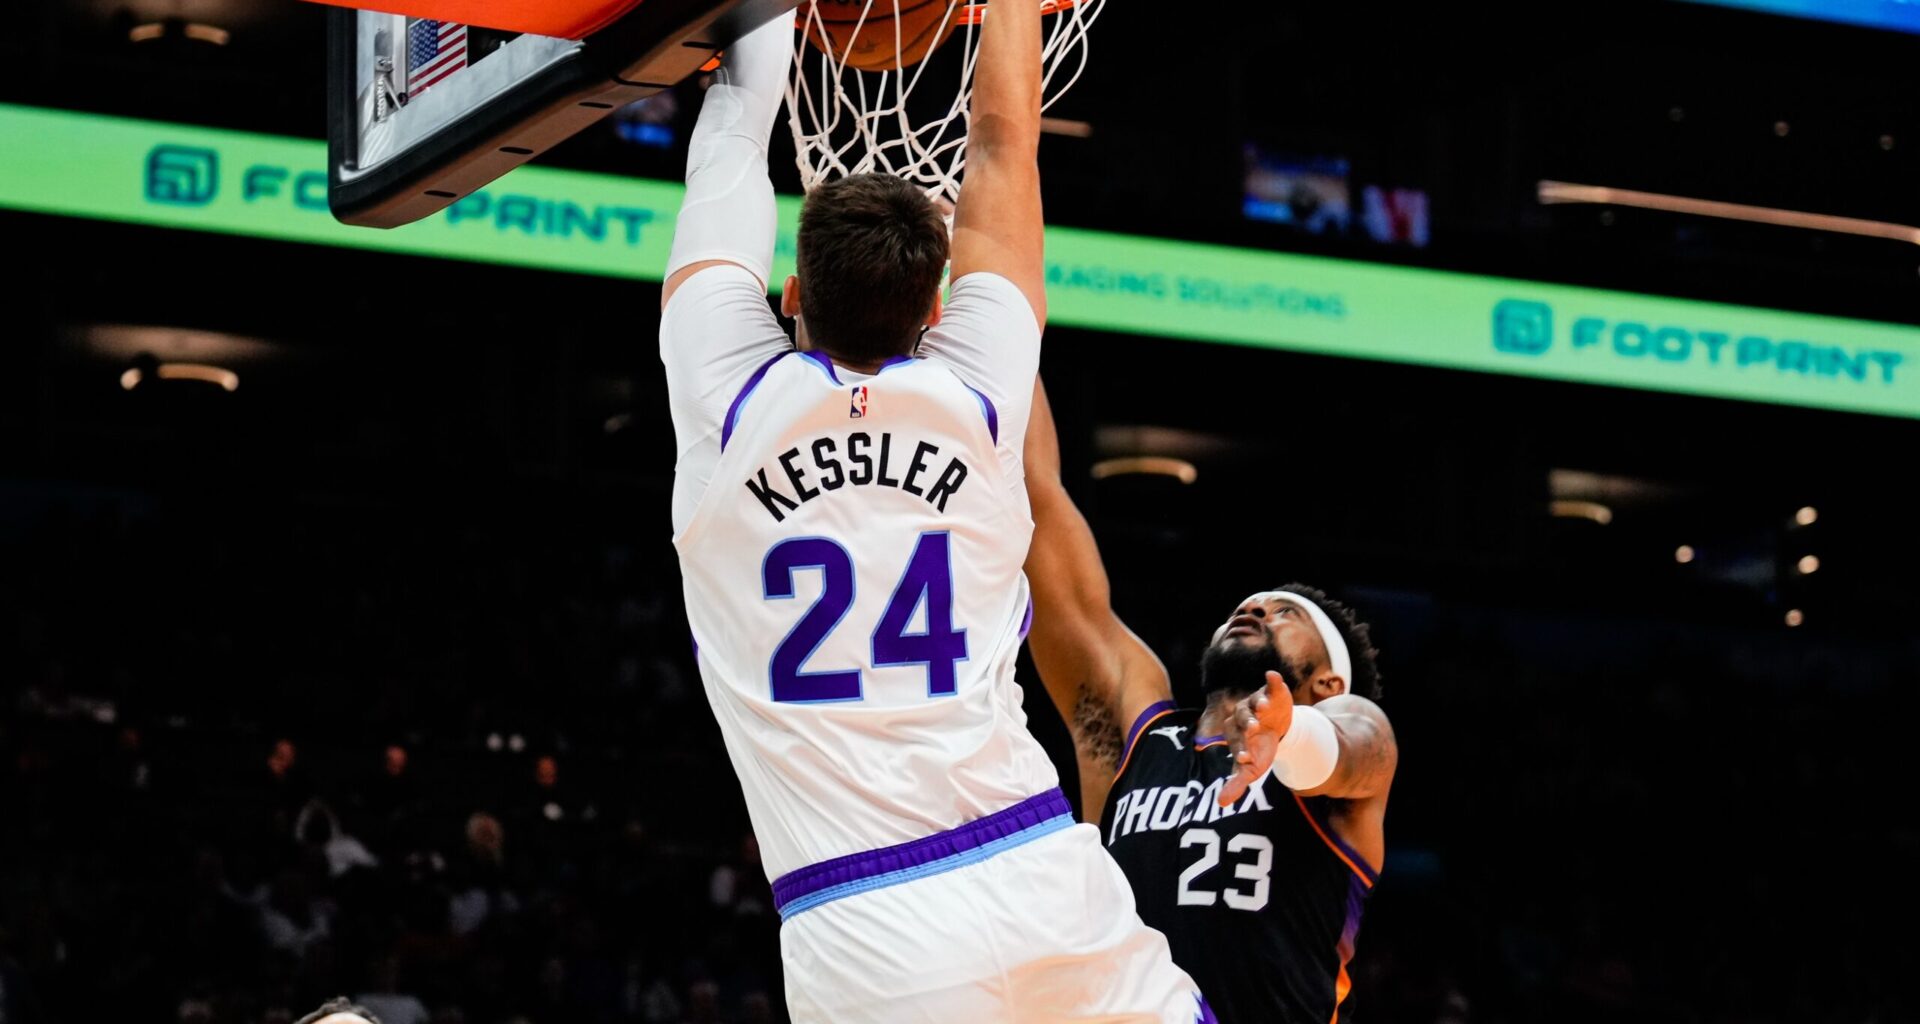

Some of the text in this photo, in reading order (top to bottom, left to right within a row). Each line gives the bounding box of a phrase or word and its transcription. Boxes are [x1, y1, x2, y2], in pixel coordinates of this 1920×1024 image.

[243, 164, 656, 246] FOPRINT
[1571, 317, 1904, 384] FOOTPRINT
[745, 432, 968, 523] KESSLER
[761, 530, 970, 705] 24
[1177, 828, 1274, 912] 23
